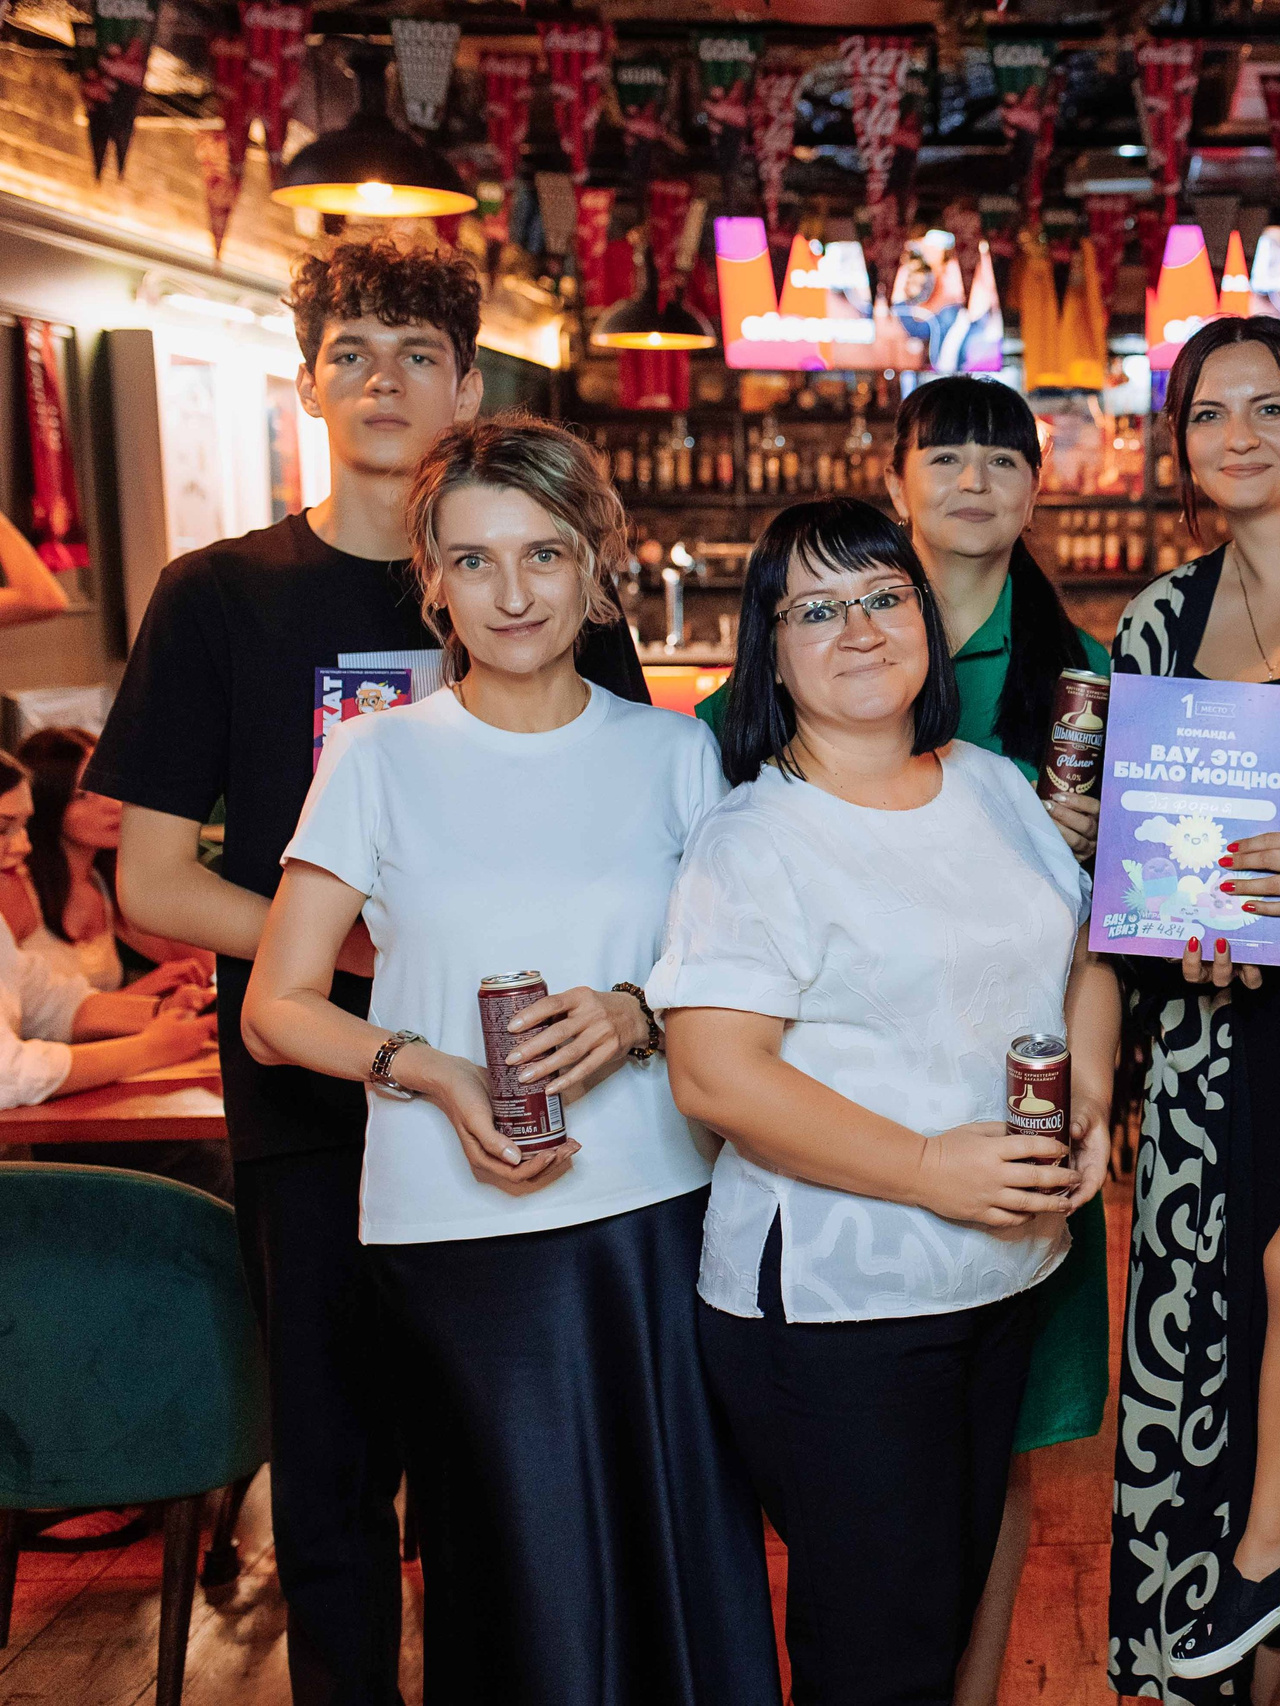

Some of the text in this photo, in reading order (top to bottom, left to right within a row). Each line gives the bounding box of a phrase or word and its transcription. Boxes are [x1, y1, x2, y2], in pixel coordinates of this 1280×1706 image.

[1180, 693, 1228, 719] 1 МЕСТО
[1176, 727, 1236, 741] КОМАНДА
[1056, 753, 1094, 768] Pilsner
[1150, 744, 1258, 769] ВАУ, ЭТО
[1113, 761, 1187, 782] БЫЛО
[1103, 913, 1127, 928] ВАУ
[1108, 924, 1136, 938] КВИЗ
[1007, 1111, 1062, 1130] ЫМКЕНТСКОЕ
